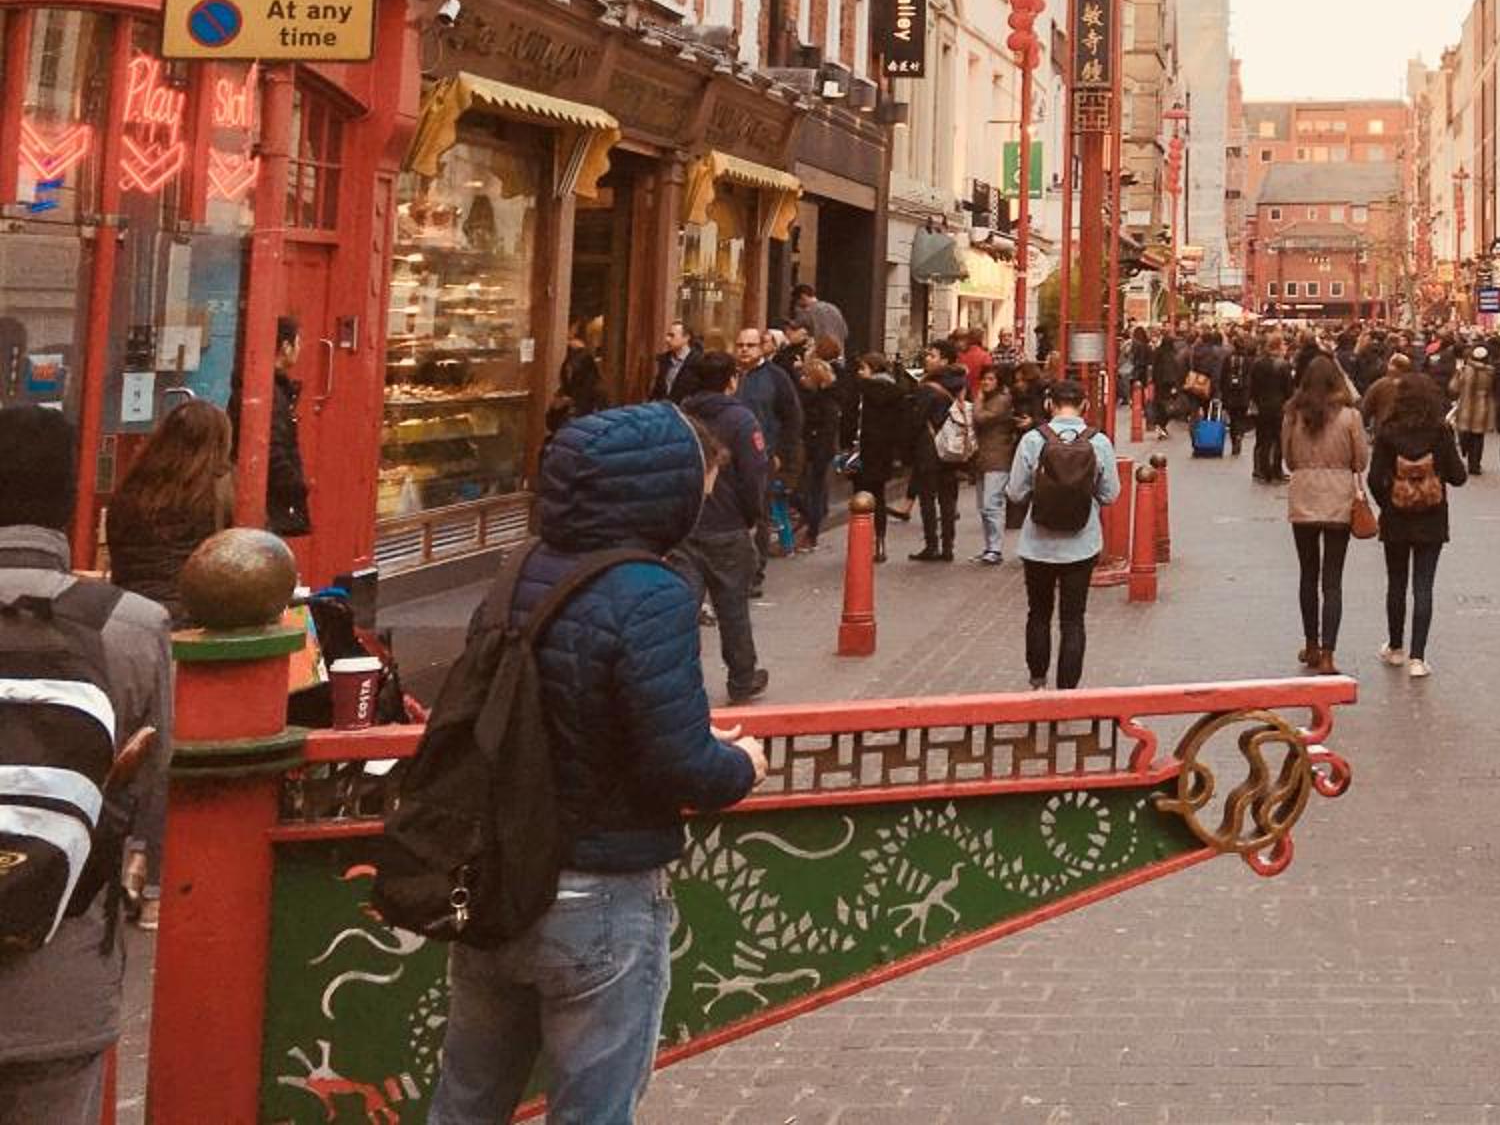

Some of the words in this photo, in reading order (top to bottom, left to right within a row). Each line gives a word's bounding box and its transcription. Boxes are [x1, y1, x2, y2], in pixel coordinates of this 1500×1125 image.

[266, 0, 297, 20] At
[306, 4, 353, 24] any
[279, 27, 338, 47] time
[123, 53, 185, 145] Play
[357, 677, 371, 720] COSTA
